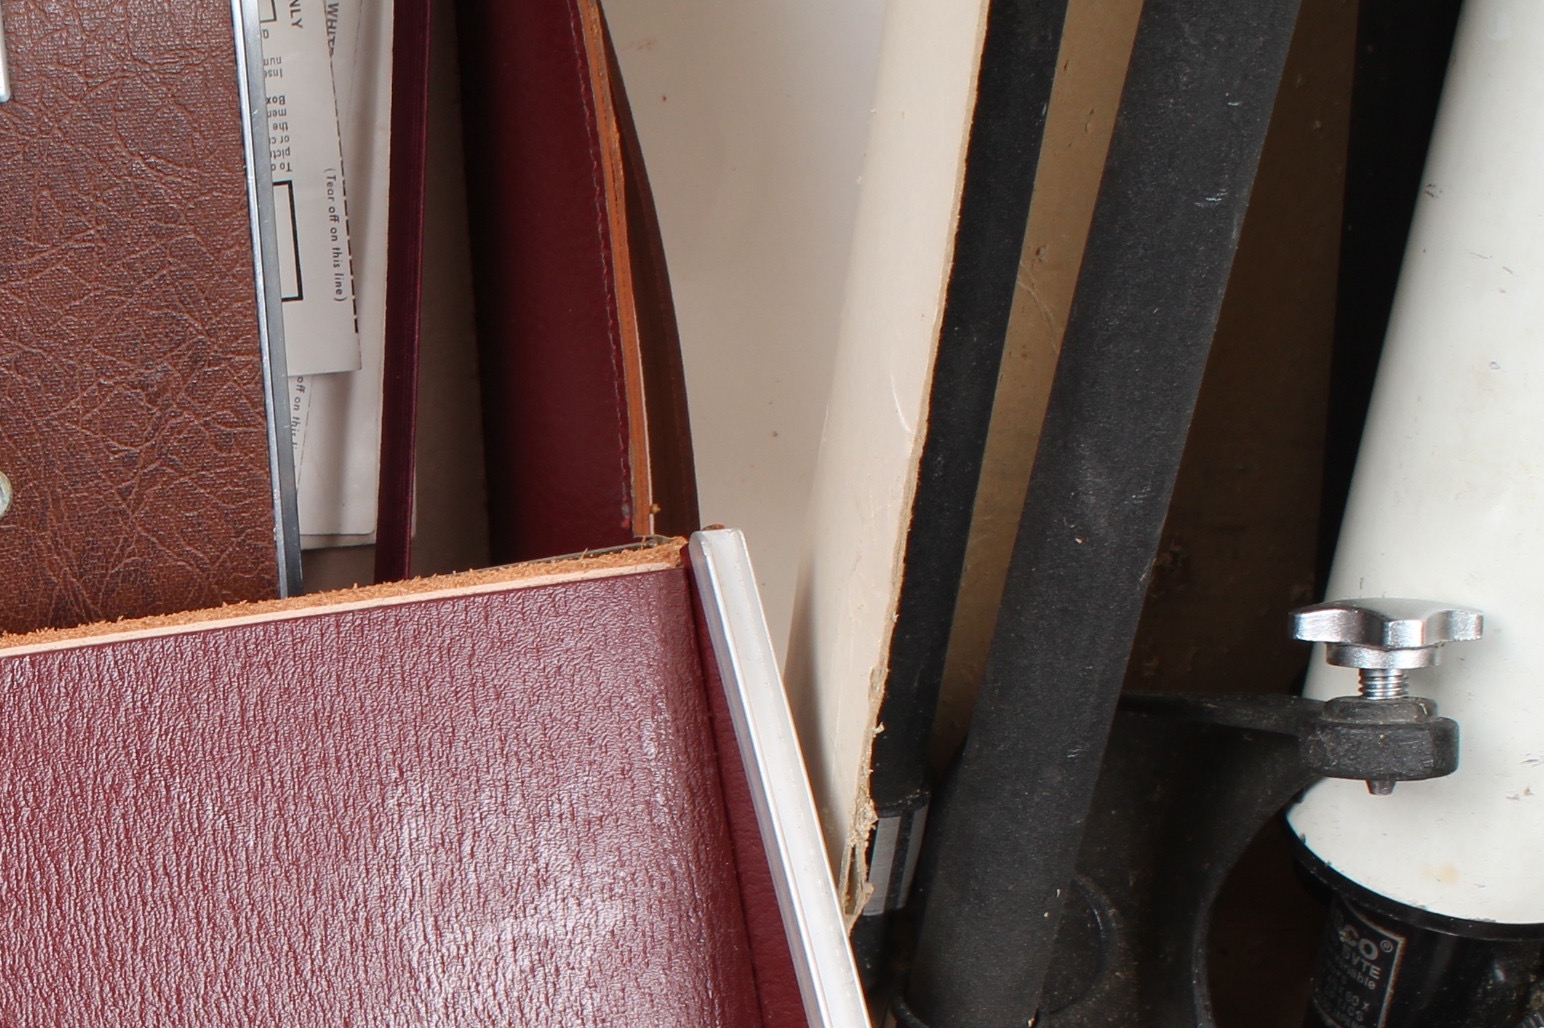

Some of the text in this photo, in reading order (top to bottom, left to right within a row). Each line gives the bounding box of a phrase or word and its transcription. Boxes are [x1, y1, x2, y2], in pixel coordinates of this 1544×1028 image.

[326, 2, 339, 58] WHIT
[265, 95, 286, 105] Box
[272, 121, 288, 132] the
[280, 135, 290, 144] or
[280, 162, 293, 172] To
[323, 168, 348, 302] (Tear off on this line)
[296, 376, 306, 394] off
[293, 396, 301, 411] on
